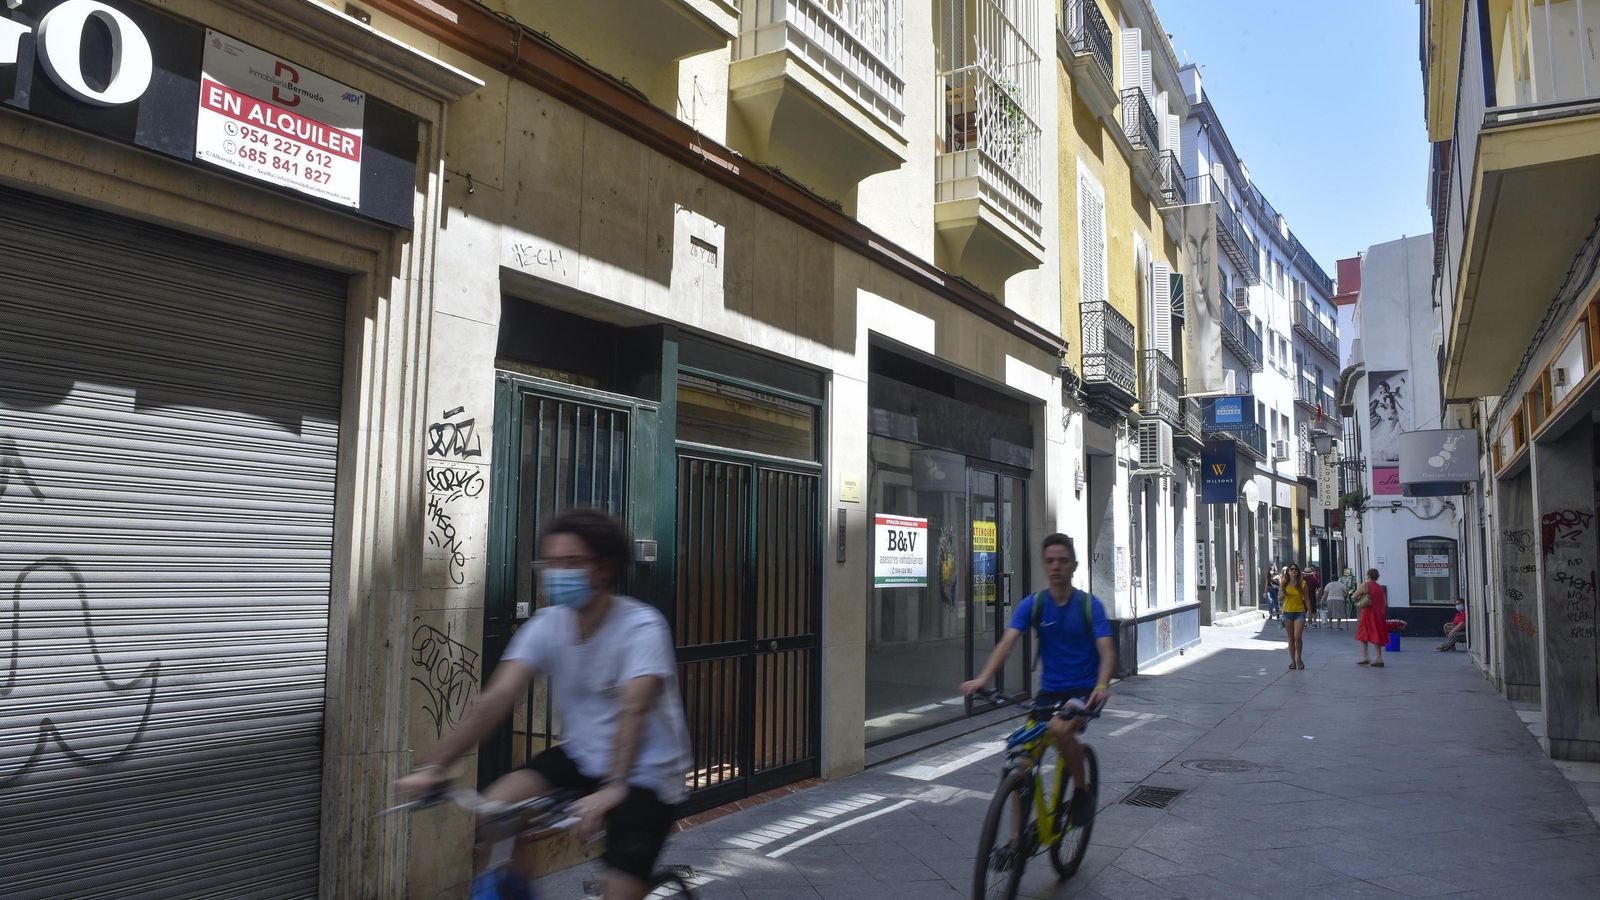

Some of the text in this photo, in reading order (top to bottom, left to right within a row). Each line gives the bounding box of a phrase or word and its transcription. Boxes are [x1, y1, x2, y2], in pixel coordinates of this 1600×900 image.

[208, 86, 356, 157] EN ALQUILER
[238, 145, 332, 185] 685 841 827
[240, 126, 332, 169] 954 227 612
[1211, 463, 1227, 476] W
[887, 529, 918, 553] B&V
